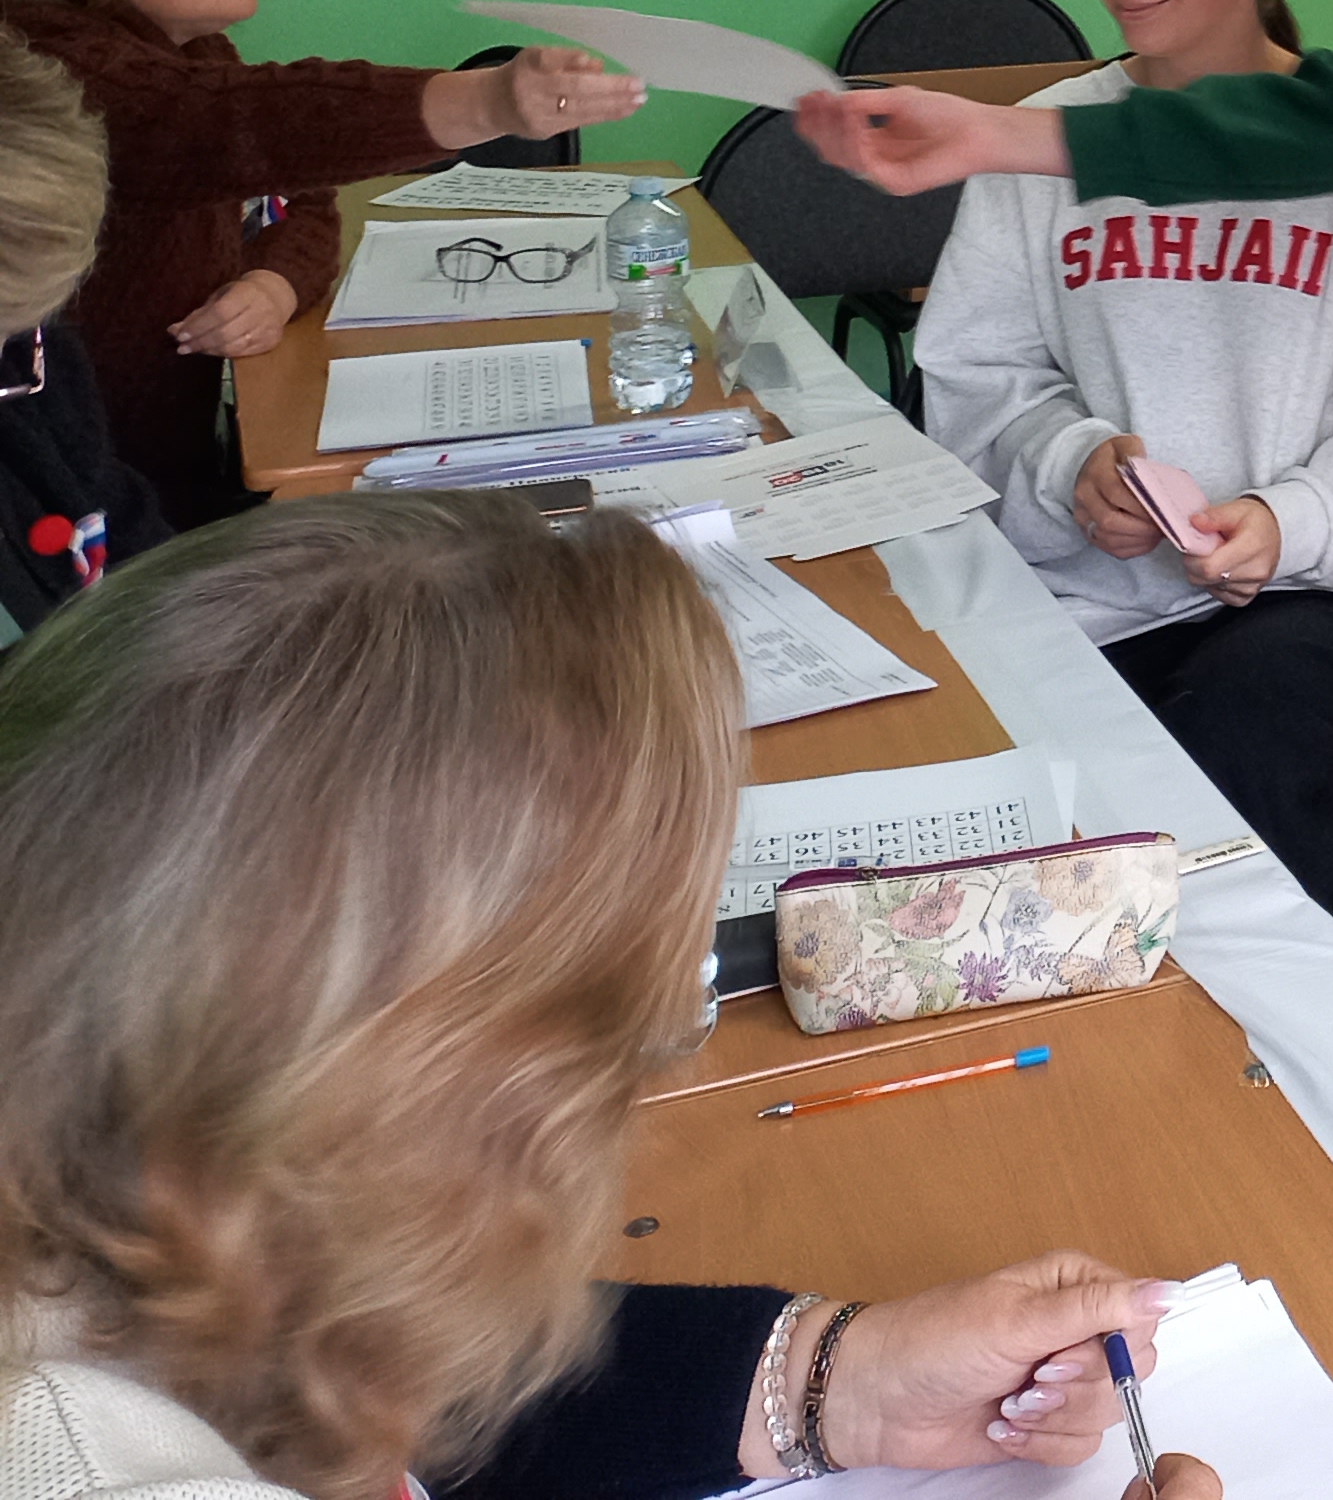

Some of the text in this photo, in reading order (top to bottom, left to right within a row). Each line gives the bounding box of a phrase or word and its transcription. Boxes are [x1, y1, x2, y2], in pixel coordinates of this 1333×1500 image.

[995, 803, 1020, 815] 41
[954, 811, 981, 821] 42
[998, 815, 1021, 828] 31
[876, 822, 904, 832] 44
[916, 817, 943, 827] 43
[836, 827, 865, 838] 45
[917, 830, 943, 841] 33
[955, 825, 983, 835] 32
[753, 837, 782, 847] 47
[794, 832, 824, 842] 46
[877, 834, 904, 846] 34
[1001, 830, 1024, 844] 21
[837, 840, 865, 852] 35
[919, 844, 946, 855] 23
[958, 838, 986, 850] 22
[753, 851, 782, 862] 37
[795, 846, 823, 856] 36
